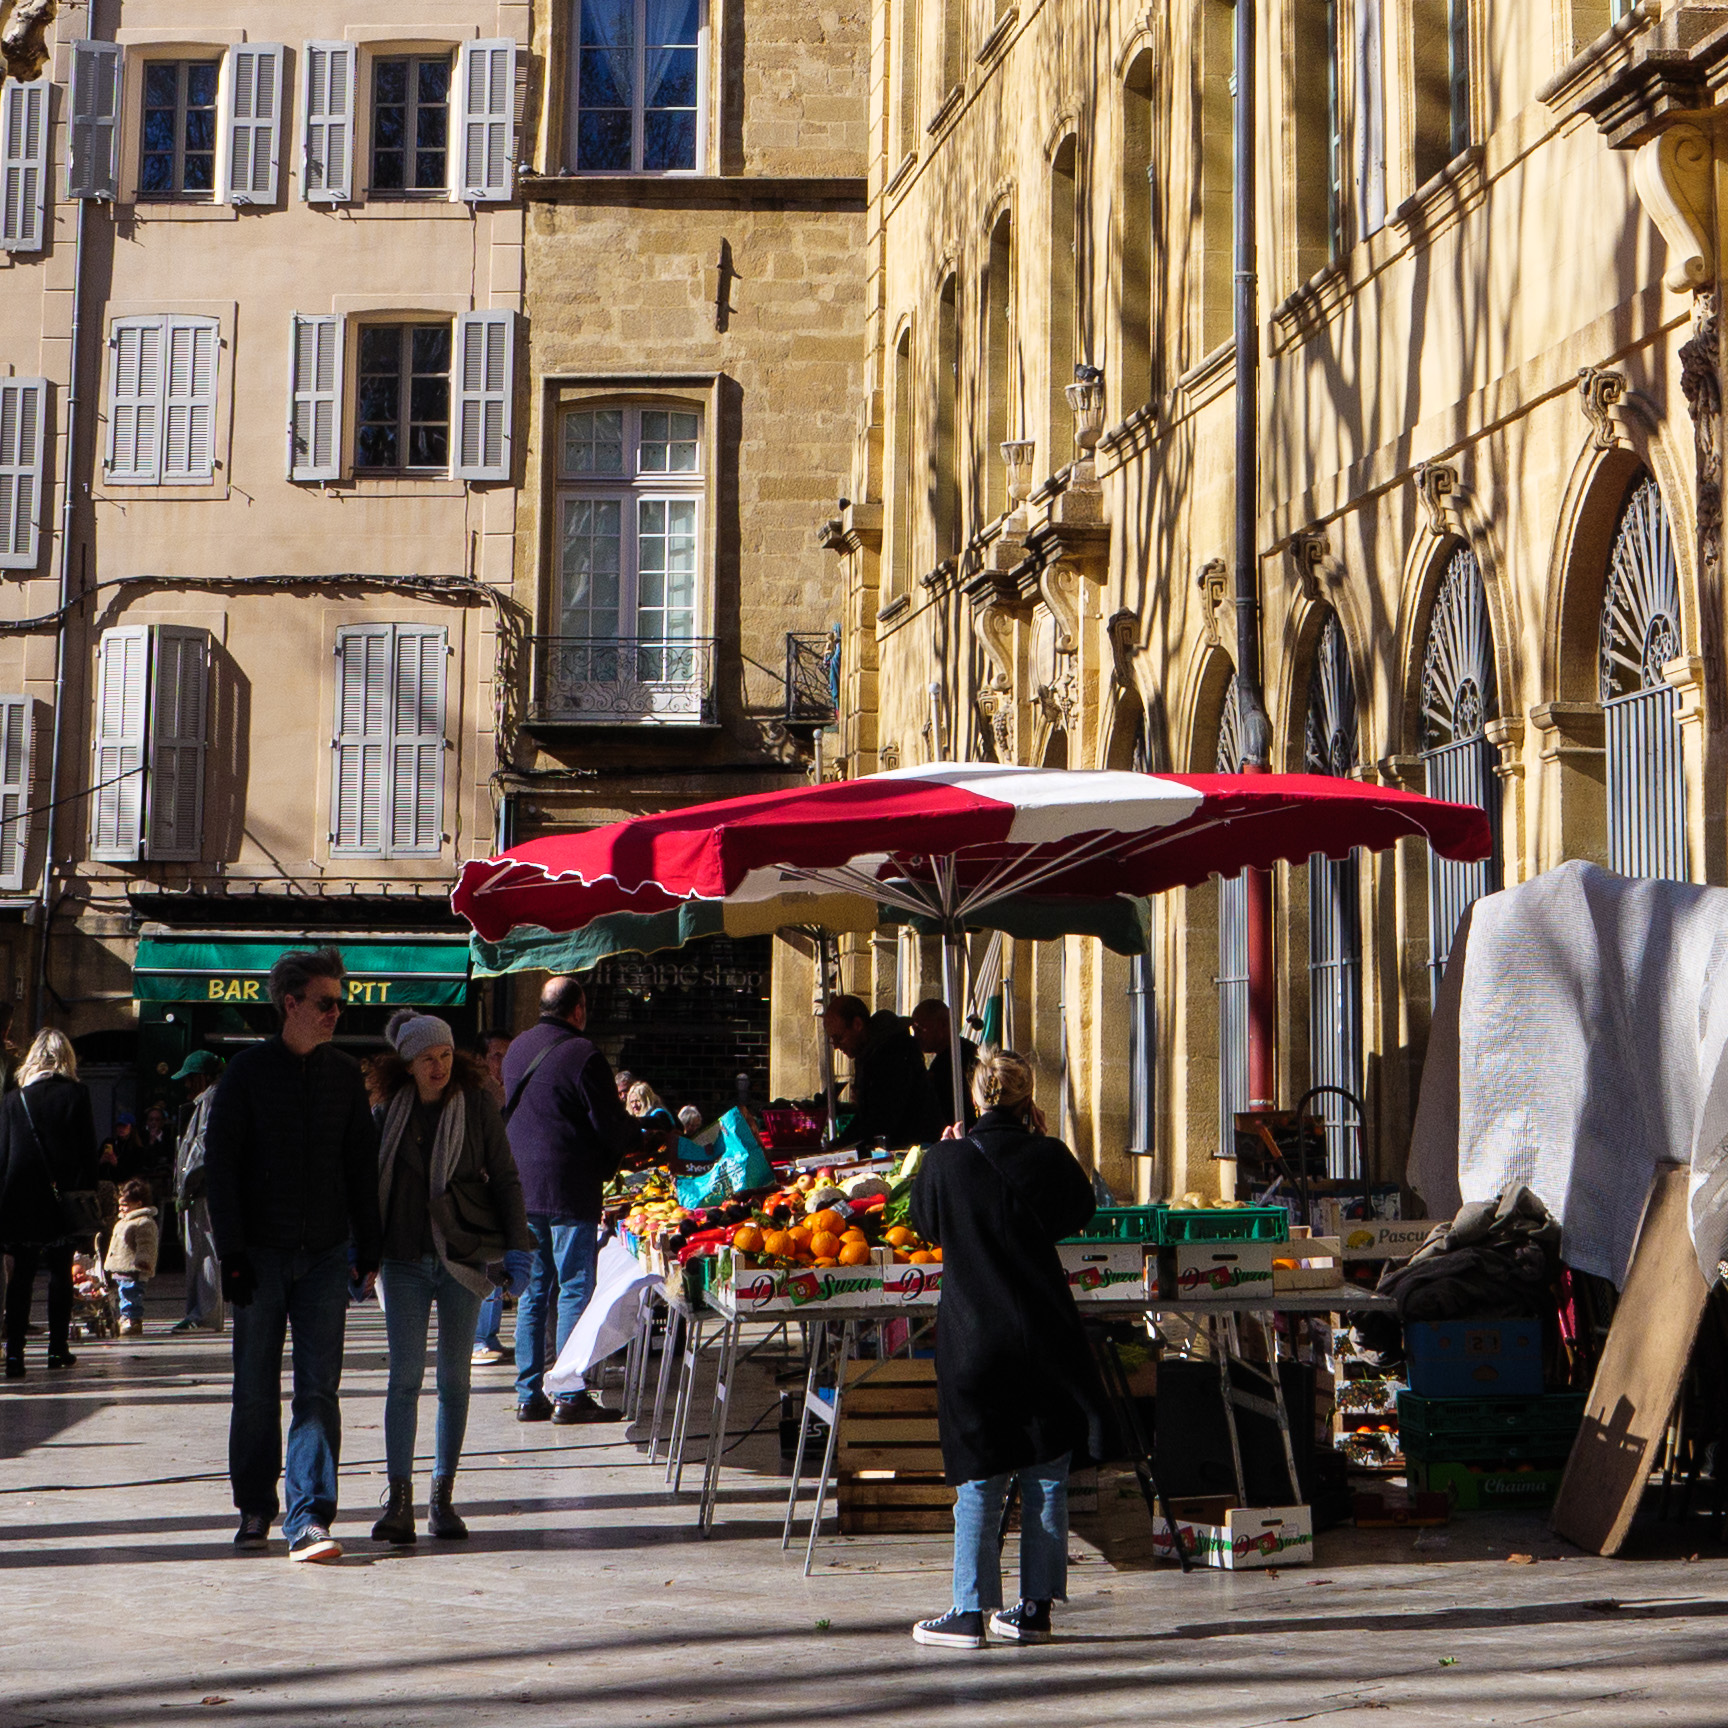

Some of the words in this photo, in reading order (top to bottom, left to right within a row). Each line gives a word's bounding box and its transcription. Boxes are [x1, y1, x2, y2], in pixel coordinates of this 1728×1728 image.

[207, 979, 261, 1001] BAR
[347, 981, 393, 1003] PTT
[814, 1272, 873, 1302] Suza
[1098, 1267, 1140, 1288] Suza
[1230, 1266, 1270, 1288] Suza
